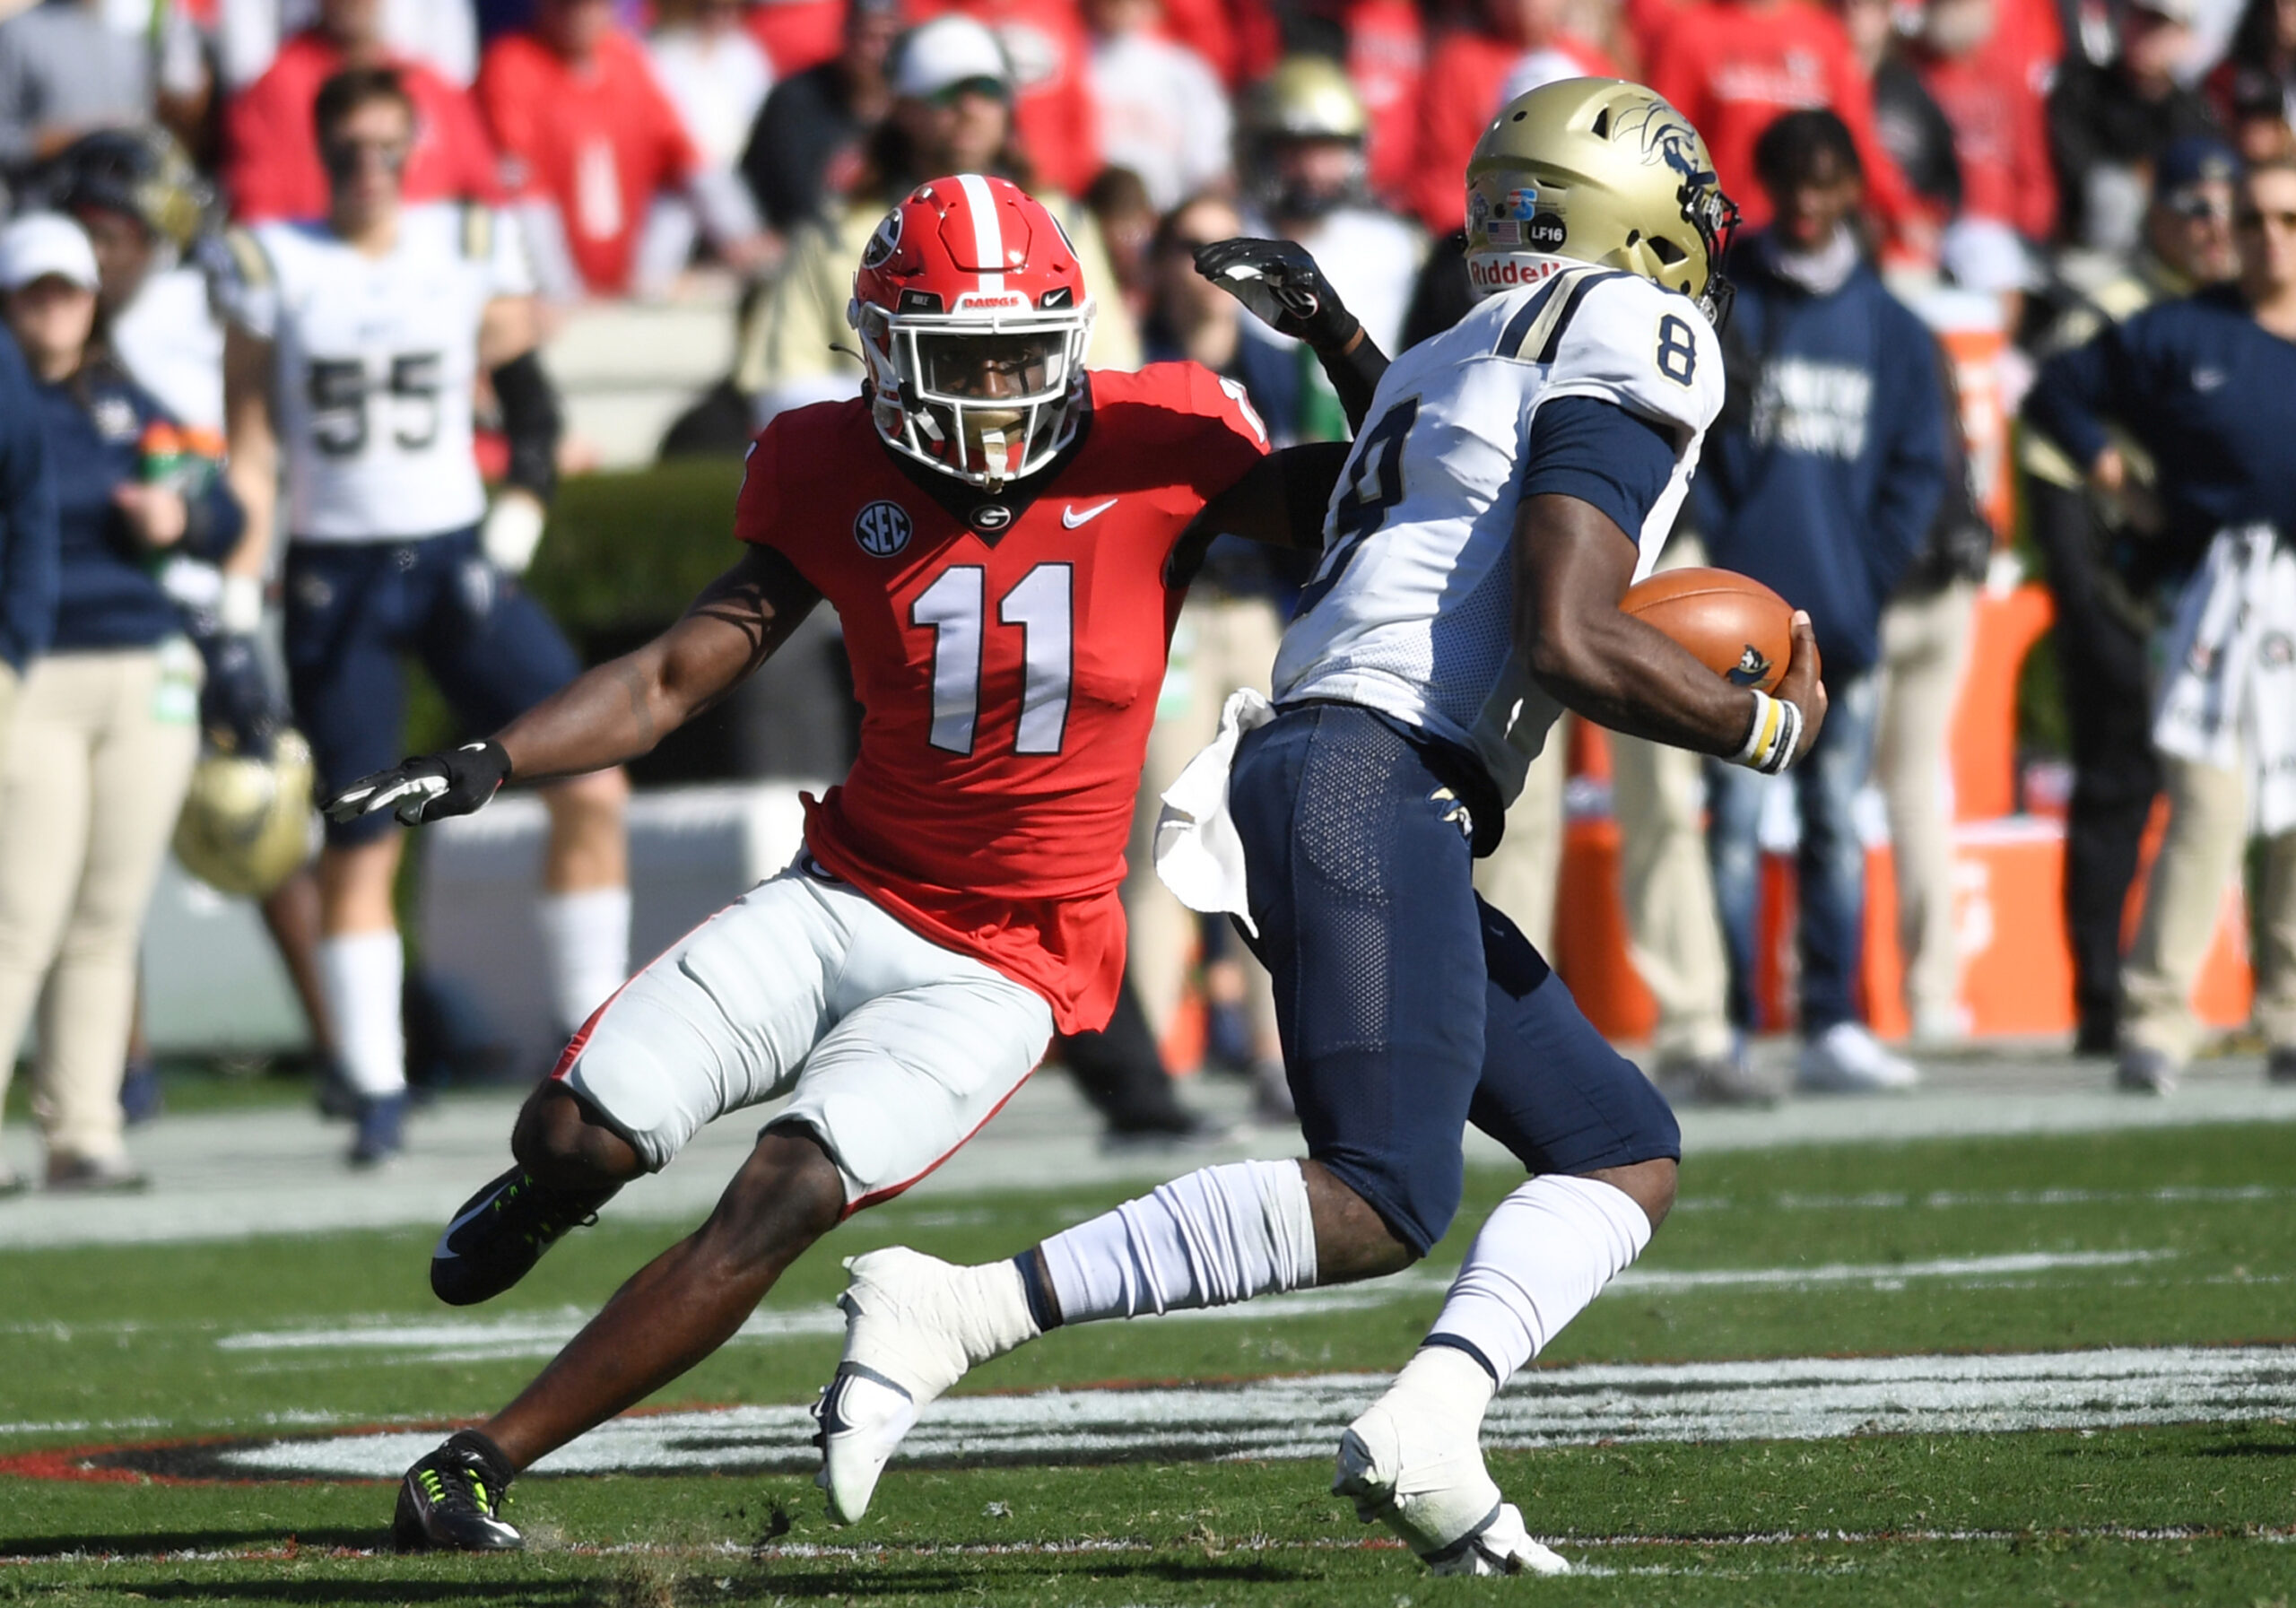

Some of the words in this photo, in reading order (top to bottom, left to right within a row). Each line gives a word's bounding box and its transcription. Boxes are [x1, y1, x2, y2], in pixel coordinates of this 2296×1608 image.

[1531, 226, 1563, 242] LF16
[1471, 259, 1561, 285] Riddel
[962, 297, 1019, 309] DAWGS
[1655, 311, 1699, 389] 8
[306, 352, 443, 456] 55
[858, 504, 906, 553] SEC
[909, 561, 1074, 756] 11
